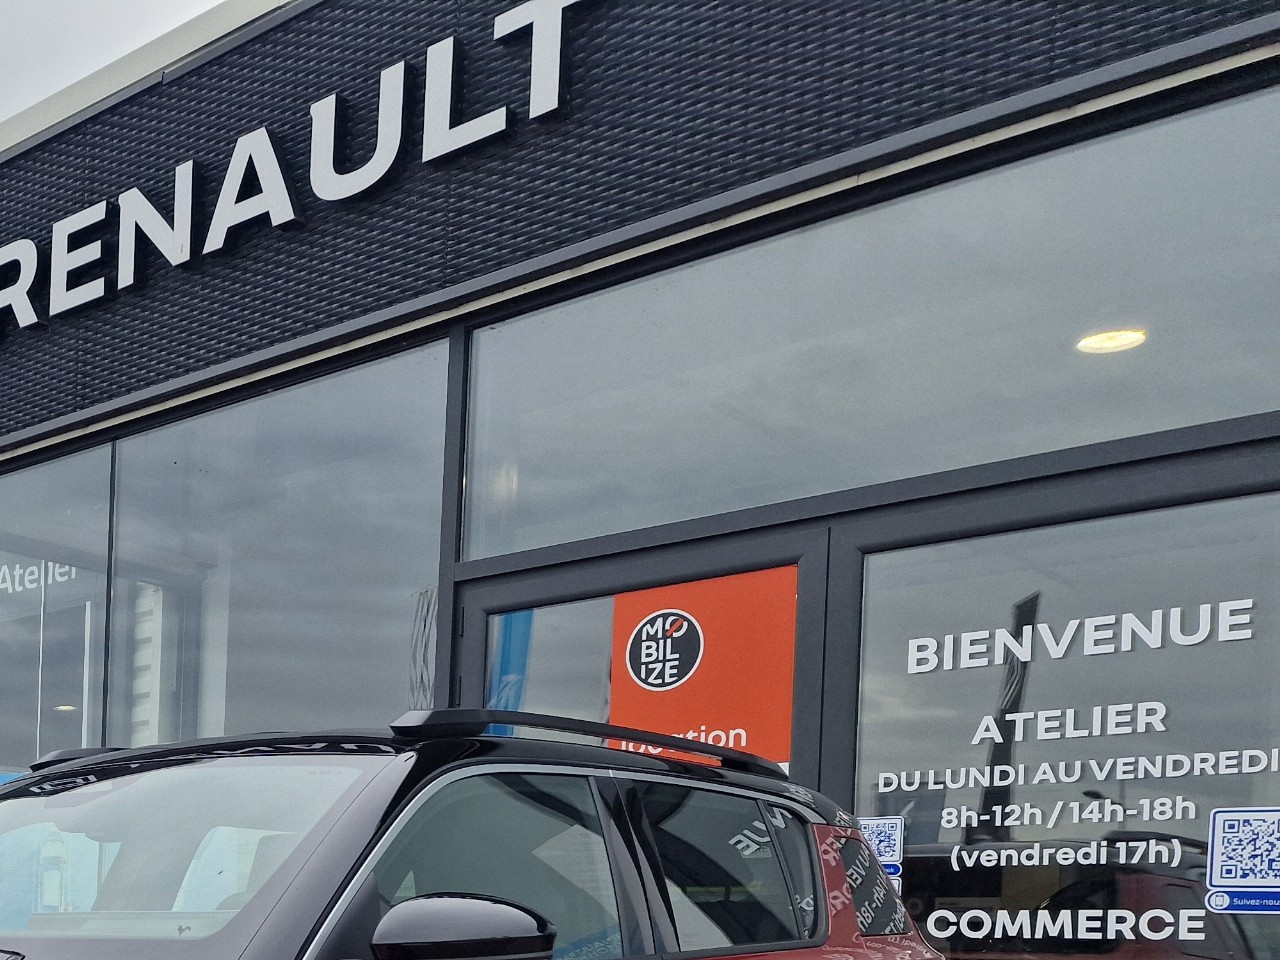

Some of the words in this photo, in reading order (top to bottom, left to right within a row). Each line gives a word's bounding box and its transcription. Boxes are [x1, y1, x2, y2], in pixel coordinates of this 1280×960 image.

[907, 599, 1255, 674] BIENVENUE
[971, 701, 1168, 745] ATELIER
[877, 771, 921, 794] DU
[927, 764, 1025, 790] LUNDI
[1032, 761, 1082, 784] AU
[1088, 748, 1280, 781] VENDREDI
[940, 803, 1043, 829] 8h-12h
[1069, 796, 1196, 825] 14h-18h
[950, 841, 1108, 872] (vendredi
[1117, 838, 1182, 868] 17h)
[1232, 897, 1280, 906] Suivez-nou
[926, 909, 1206, 940] COMMERCE
